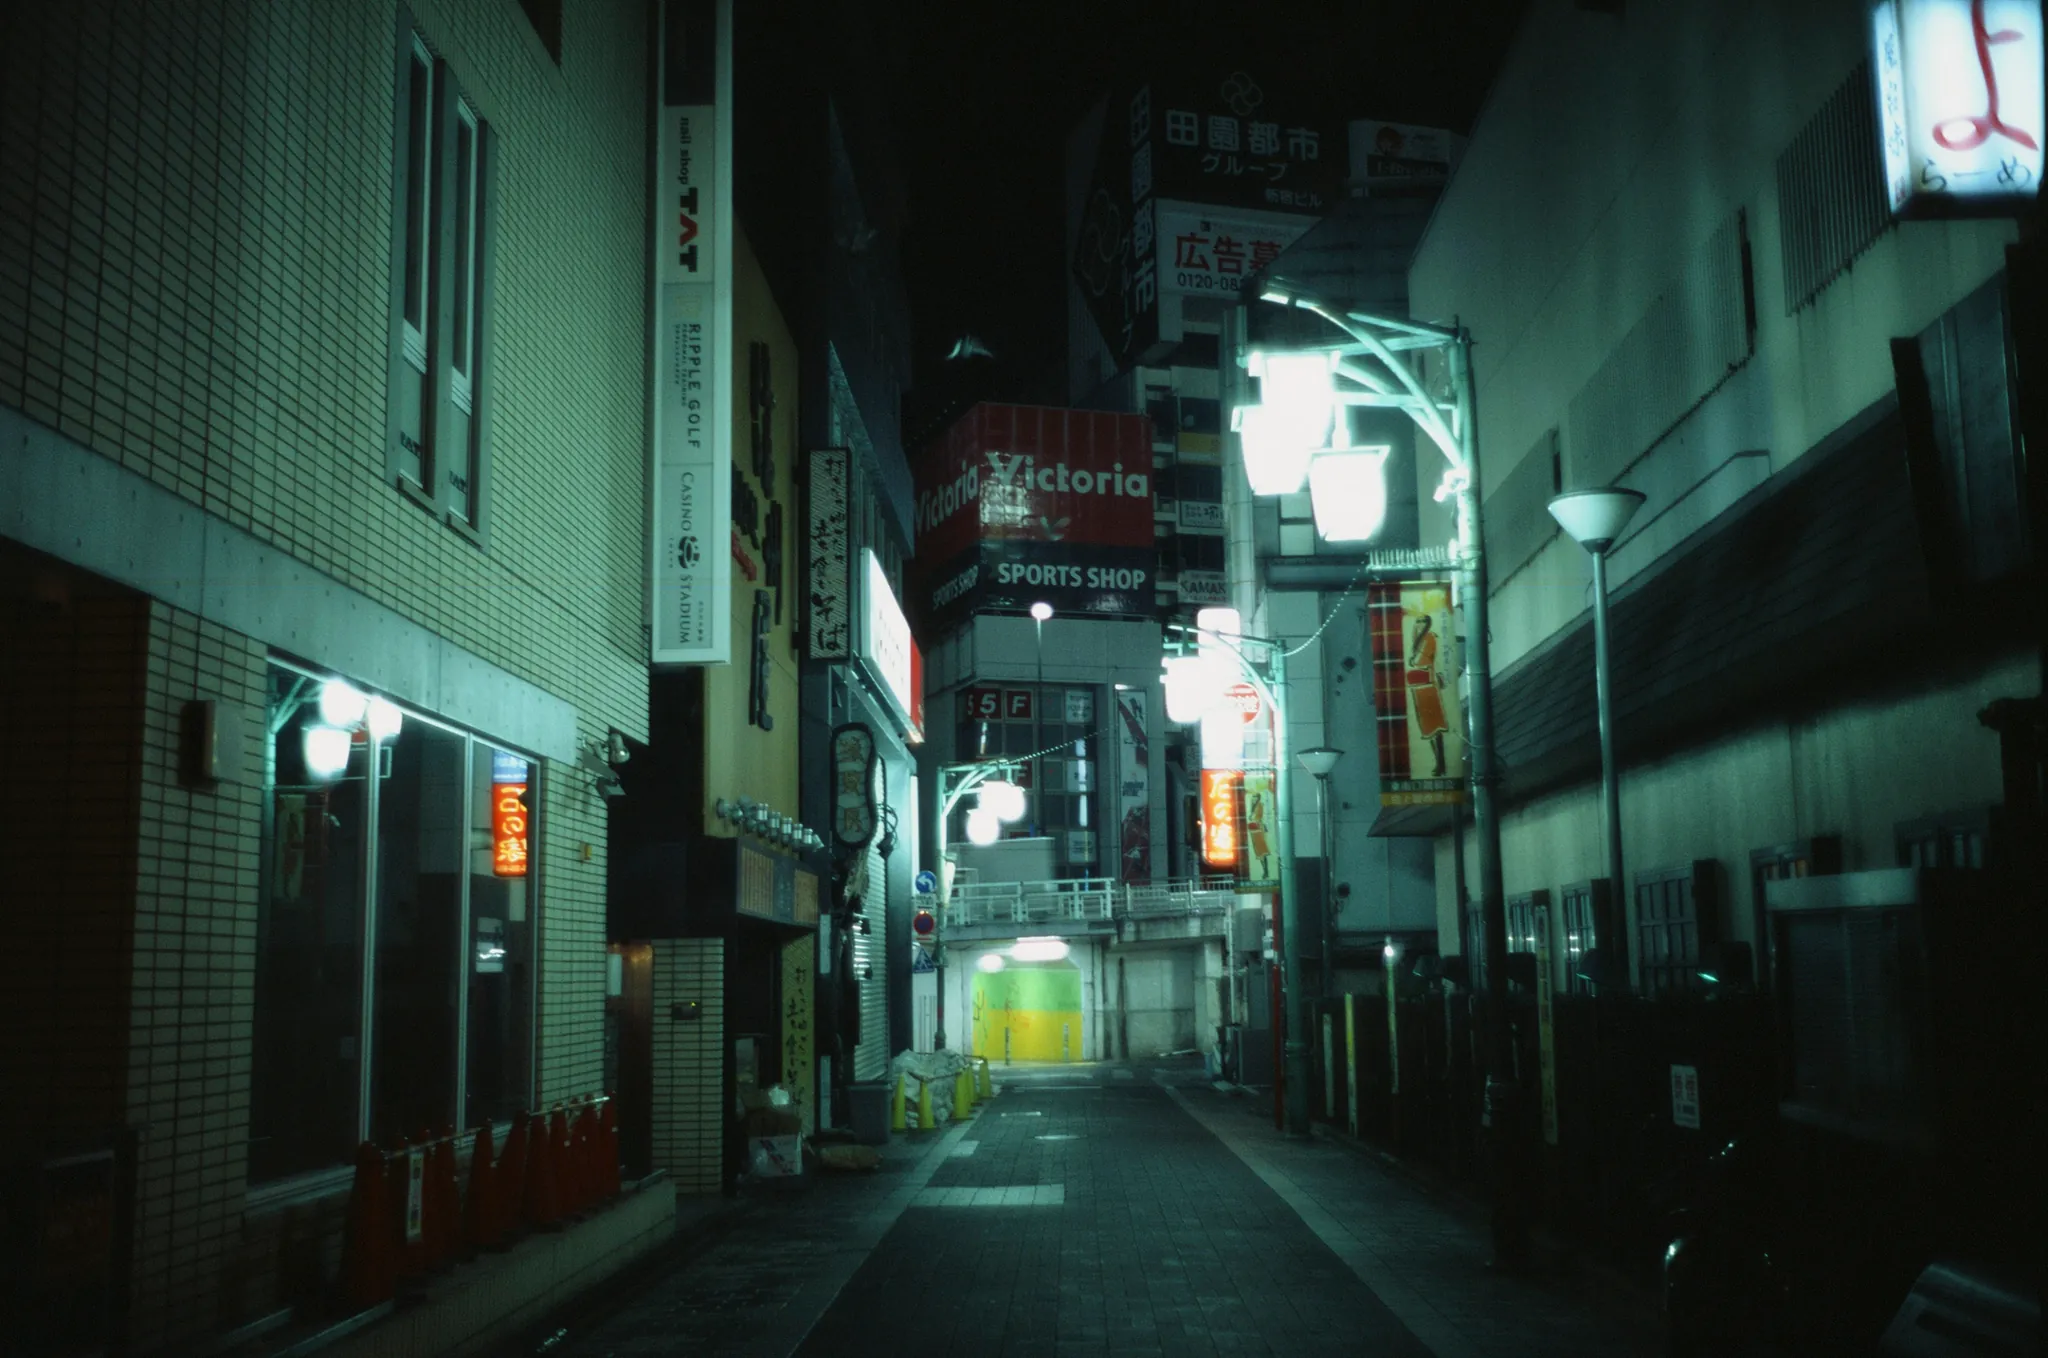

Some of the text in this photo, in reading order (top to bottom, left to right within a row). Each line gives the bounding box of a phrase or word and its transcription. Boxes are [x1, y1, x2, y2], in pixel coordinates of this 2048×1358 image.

[677, 116, 691, 185] nail shop
[1166, 108, 1320, 162] 田園都市
[1201, 152, 1289, 181] グループ
[679, 187, 698, 272] TAT
[687, 323, 701, 448] RIPPLE GOLF
[914, 459, 979, 536] Victoria
[985, 450, 1149, 498] Victoria
[679, 472, 695, 643] CASINO STADIUM
[997, 562, 1146, 590] SPORTS SHOP
